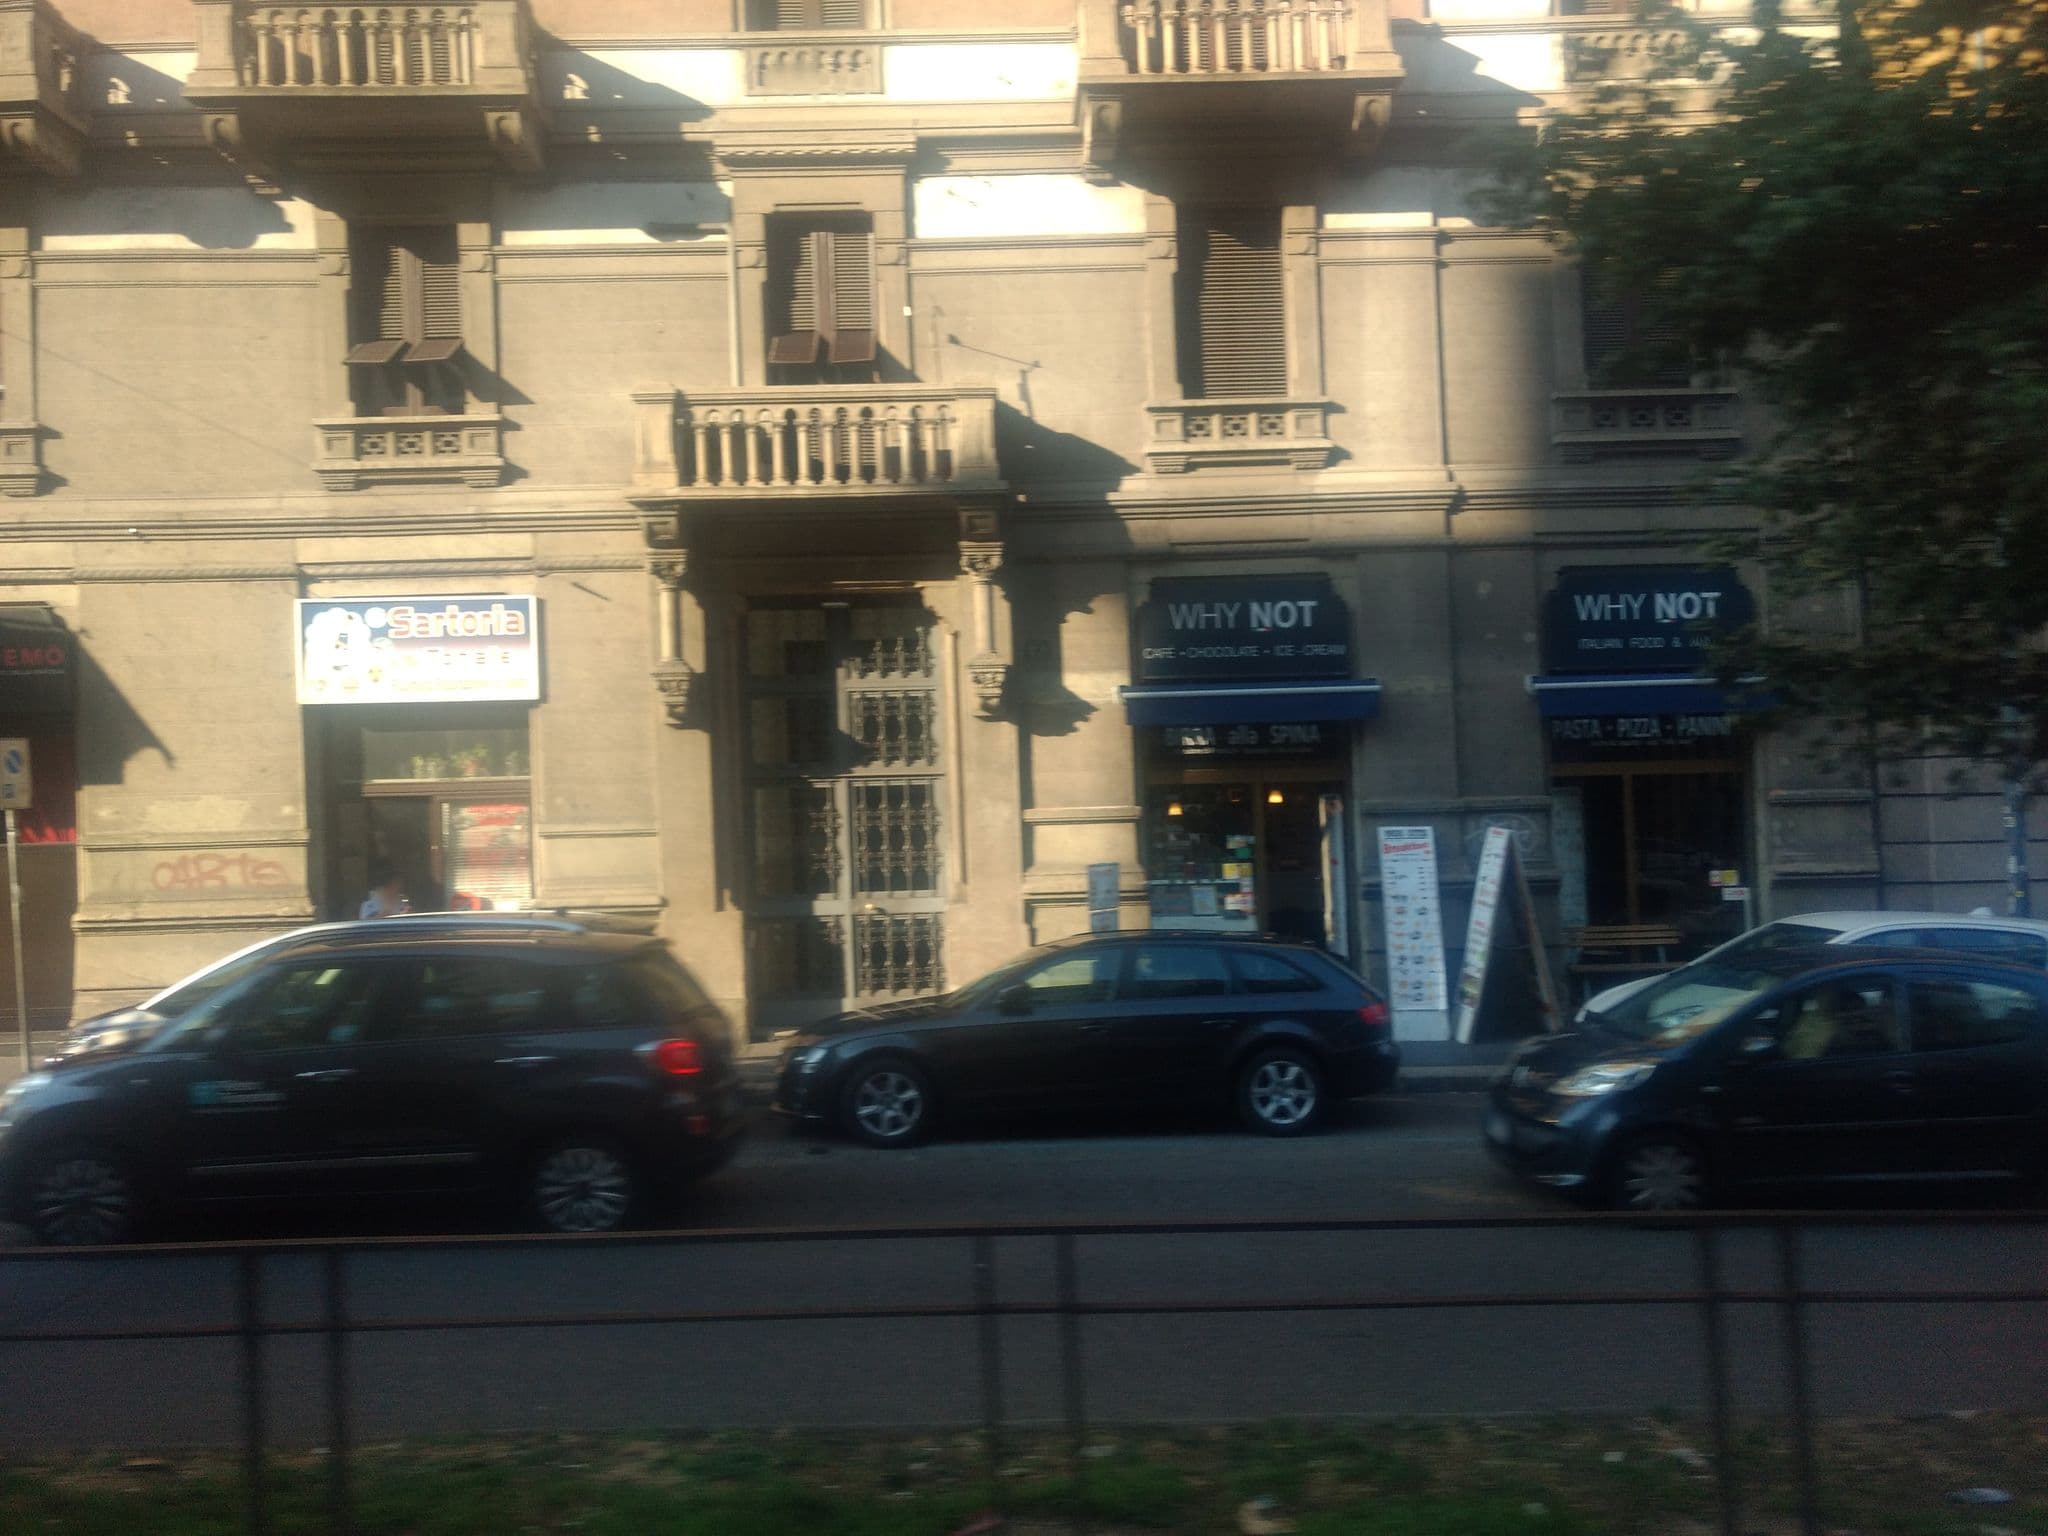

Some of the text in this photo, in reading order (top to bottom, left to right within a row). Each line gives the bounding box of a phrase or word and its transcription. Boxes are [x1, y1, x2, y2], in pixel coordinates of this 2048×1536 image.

[1169, 600, 1318, 630] WHY NOT
[1574, 592, 1722, 621] WHY NOT
[387, 604, 526, 639] Sartoria
[1629, 637, 1666, 649] FOOD
[1616, 717, 1662, 737] PIZZA
